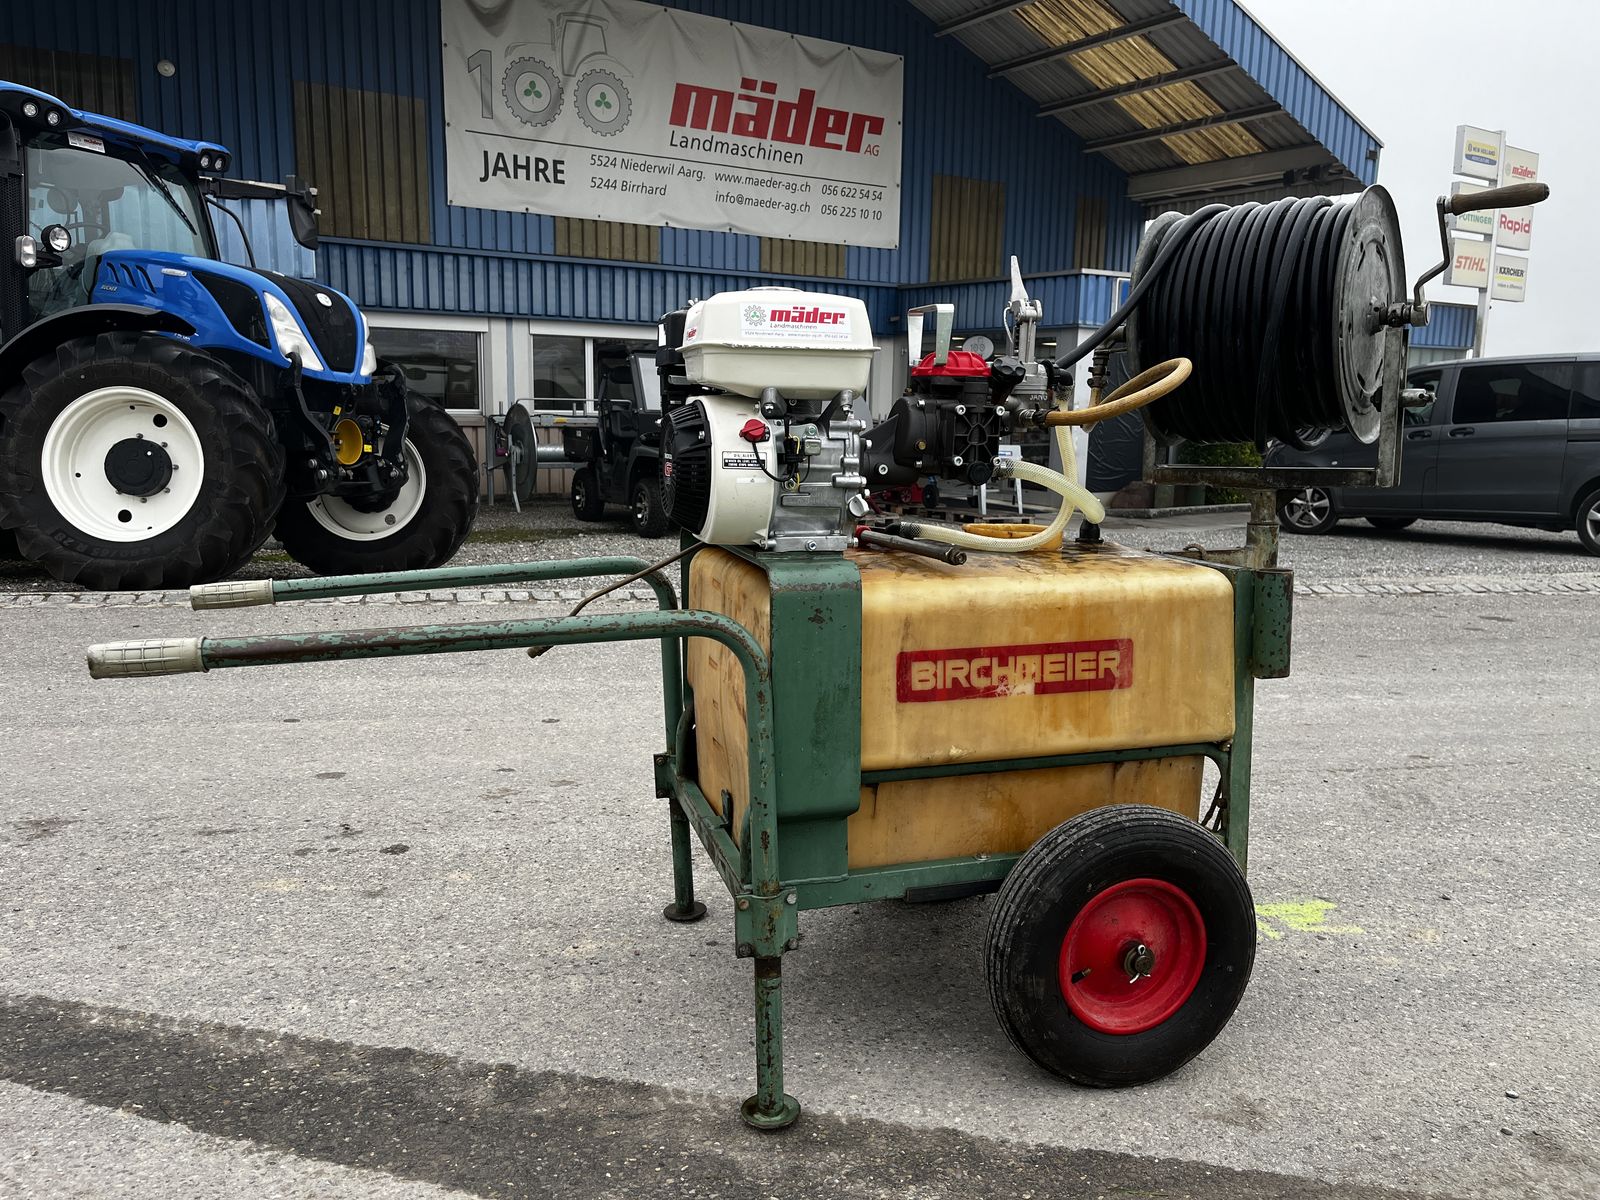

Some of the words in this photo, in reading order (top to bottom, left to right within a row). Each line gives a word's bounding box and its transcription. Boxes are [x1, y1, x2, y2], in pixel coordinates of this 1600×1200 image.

[669, 77, 884, 153] mäder
[864, 144, 880, 157] AG
[669, 130, 804, 165] Landmaschinen
[480, 150, 566, 185] JAHRE
[590, 154, 617, 169] 5524
[620, 158, 675, 176] Niederwil
[677, 165, 706, 182] Aarg.
[715, 170, 811, 194] www.maeder-ag.ch
[821, 184, 838, 196] 056
[840, 186, 857, 199] 622
[859, 188, 870, 200] 54
[872, 190, 883, 202] 54
[590, 177, 617, 191] 5244
[620, 180, 667, 196] Birrhard
[715, 191, 811, 214] info@maeder-ag.ch
[820, 204, 838, 216] 056
[840, 206, 857, 218] 225
[860, 208, 869, 220] 10
[872, 210, 882, 221] 10
[1499, 214, 1531, 234] Rapid
[1455, 255, 1486, 272] STIHL
[770, 306, 845, 324] mäder
[911, 650, 1120, 691] BIRCHMEIER
